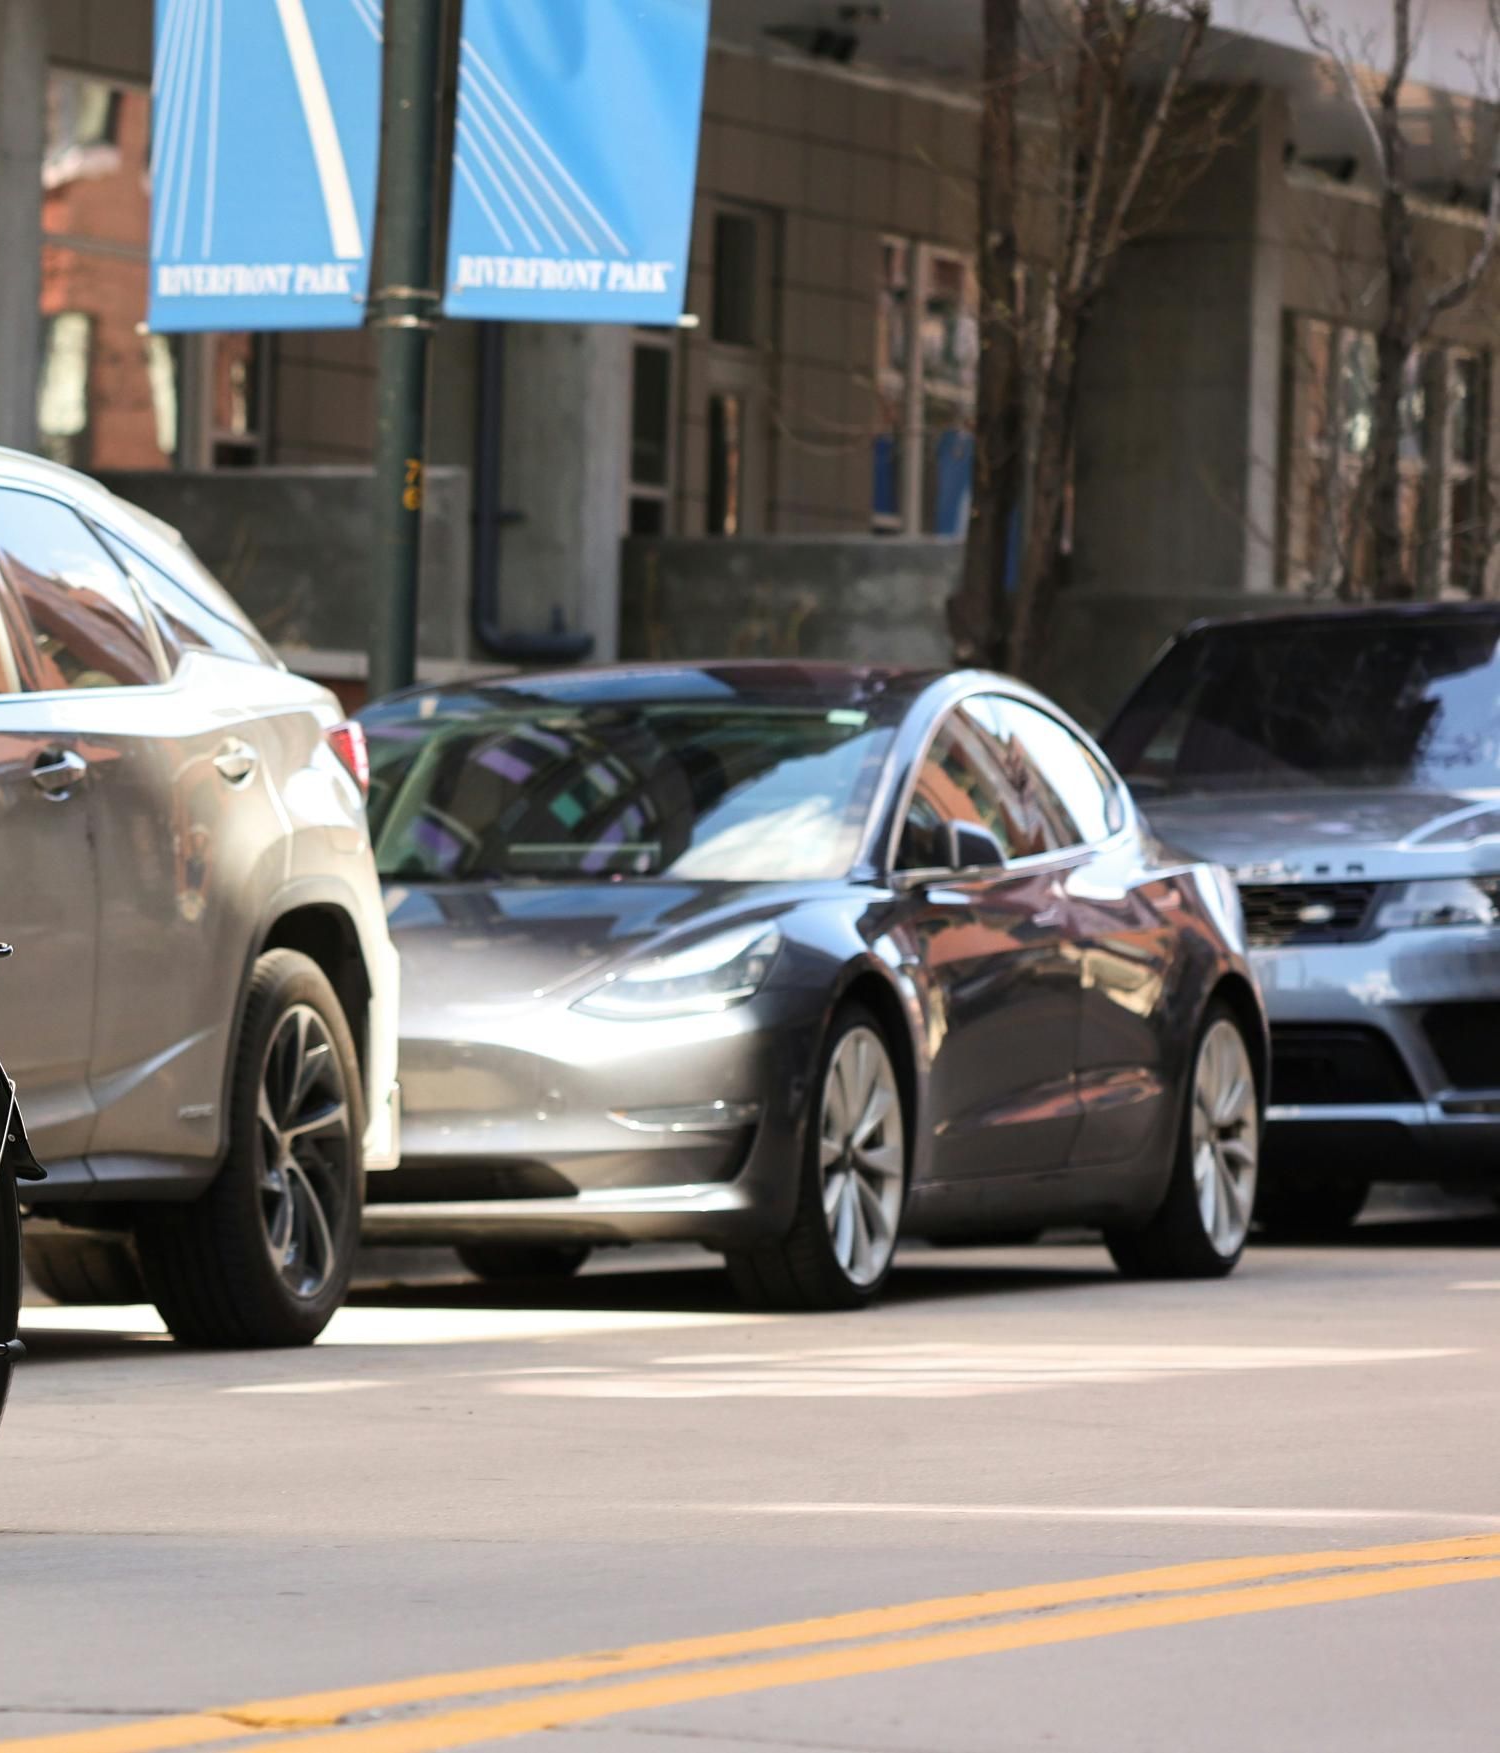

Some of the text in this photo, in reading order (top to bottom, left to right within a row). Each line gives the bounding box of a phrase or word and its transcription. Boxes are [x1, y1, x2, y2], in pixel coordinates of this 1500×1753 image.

[158, 263, 350, 296] RIVERFRONT PARK
[457, 255, 668, 293] RIVERFRONT PARK
